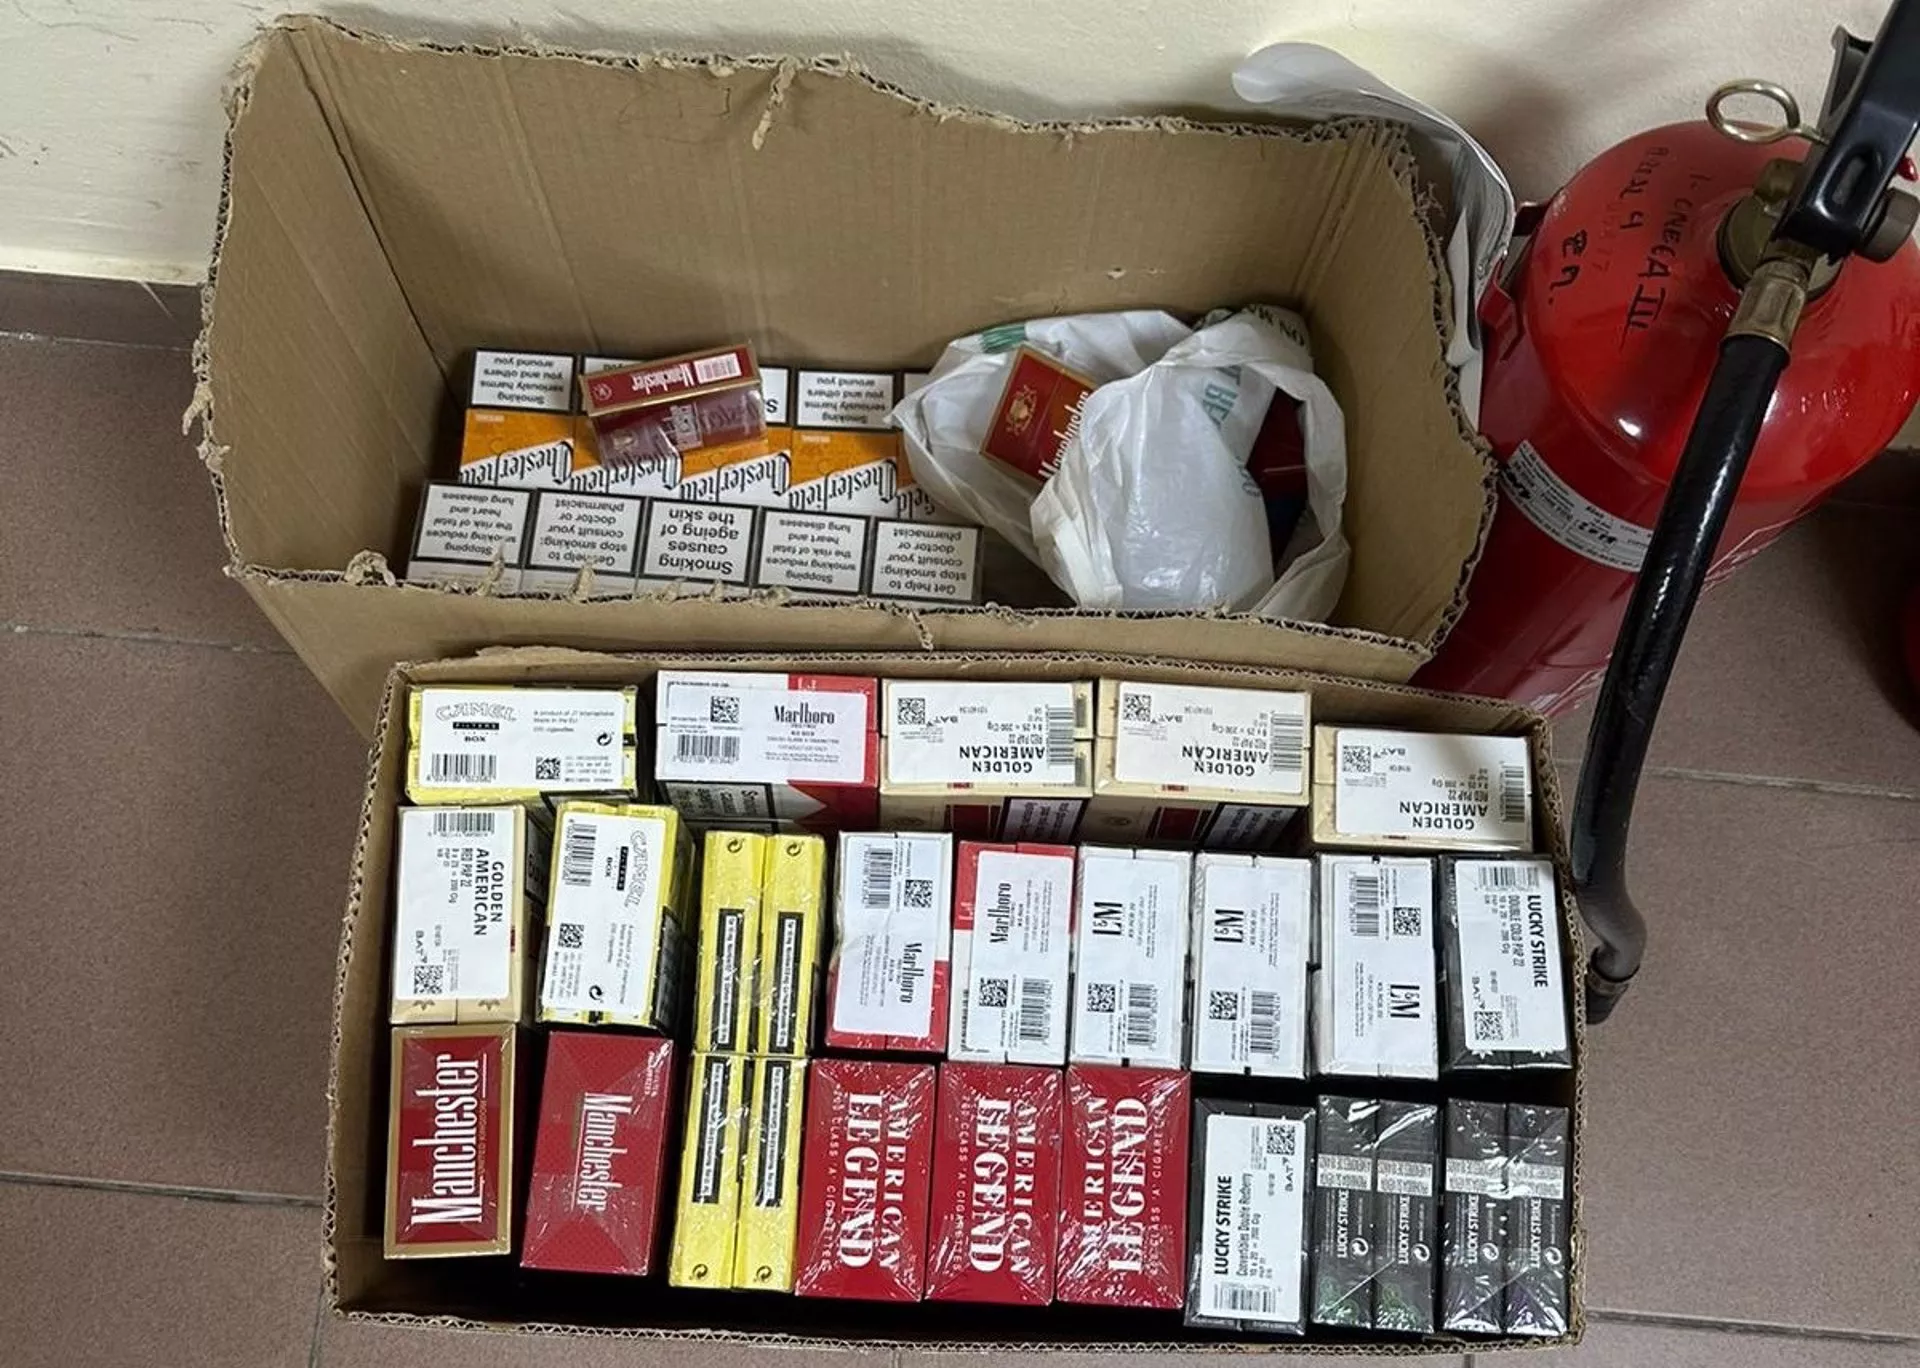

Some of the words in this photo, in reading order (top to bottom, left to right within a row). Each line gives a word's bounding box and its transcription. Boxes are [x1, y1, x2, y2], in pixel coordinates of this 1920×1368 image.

[494, 358, 514, 368] you
[497, 392, 544, 405] Smoking
[680, 453, 791, 503] Chesterfield
[788, 460, 897, 511] Chesterfield
[442, 492, 488, 504] diseases
[491, 495, 514, 506] lung
[449, 506, 470, 515] and
[473, 508, 501, 517] heart
[555, 499, 625, 513] pharmacist
[559, 513, 572, 523] or
[575, 515, 616, 525] doctor
[669, 509, 703, 522] skin
[708, 512, 734, 525] the
[459, 519, 471, 528] of
[474, 520, 493, 530] risk
[548, 525, 575, 534] your
[660, 524, 677, 537] of
[779, 520, 825, 531] diseases
[828, 522, 851, 534] lung
[578, 527, 624, 539] consult
[682, 523, 739, 540] ageing
[788, 532, 809, 542] and
[892, 528, 961, 541] pharmacist
[811, 534, 840, 544] heart
[445, 543, 493, 555] Stopping
[600, 541, 627, 553] stop
[668, 541, 727, 555] causes
[772, 544, 796, 554] fatal
[798, 547, 810, 556] of
[812, 548, 832, 557] risk
[898, 542, 911, 552] or
[914, 544, 955, 554] doctor
[548, 551, 560, 561] to
[834, 550, 852, 559] the
[887, 552, 914, 564] your
[917, 556, 962, 567] consult
[659, 553, 733, 575] Smoking
[766, 558, 808, 569] reduces
[811, 559, 856, 573] smoking
[785, 570, 833, 584] Stopping
[880, 566, 936, 578] smoking:
[939, 569, 967, 580] stop
[889, 580, 901, 590] to
[904, 580, 931, 592] help
[934, 583, 956, 595] Get
[435, 701, 517, 722] CAMEL
[774, 702, 835, 724] Marlboro
[959, 746, 1045, 759] AMERICAN
[1181, 745, 1269, 764] AMERICAN
[972, 761, 1032, 773] GOLDEN
[1194, 761, 1254, 777] GOLDEN
[1399, 801, 1489, 816] AMERICAN
[1412, 816, 1474, 830] GOLDEN
[605, 857, 613, 877] BOX
[624, 831, 648, 908] CAMEL
[474, 848, 489, 936] AMERICAN
[490, 861, 504, 923] GOLDEN
[987, 883, 1012, 943] Marlboro
[1092, 902, 1123, 937] L&M
[1528, 895, 1544, 938] LUCKY
[1214, 908, 1244, 943] L&M
[1531, 940, 1548, 987] STRIKE
[900, 942, 924, 1003] Marlboro
[1390, 984, 1420, 1018] L&M
[410, 1054, 483, 1225] Manchester
[829, 1117, 839, 1157] CLASS
[959, 1122, 968, 1161] CLASS
[576, 1092, 633, 1212] Manchester
[838, 1092, 883, 1267] LEGEND
[879, 1095, 909, 1269] AMERICAN
[968, 1098, 1011, 1272] LEGEND
[1010, 1100, 1038, 1272] AMERICAN
[1108, 1098, 1147, 1273] LEGEND
[1152, 1183, 1160, 1199] 'A'
[1216, 1176, 1232, 1226] STRIKE
[1338, 1190, 1349, 1225] STRIKE
[1399, 1195, 1410, 1230] STRIKE
[1468, 1194, 1479, 1229] STRIKE
[1531, 1199, 1541, 1233] STRIKE
[1150, 1207, 1160, 1246] CLASS
[1337, 1227, 1348, 1258] LUCKY
[1399, 1231, 1410, 1264] LUCKY
[1468, 1231, 1478, 1264] LUCKY
[1214, 1228, 1229, 1275] LUCKY
[1531, 1235, 1541, 1268] LUCKY
